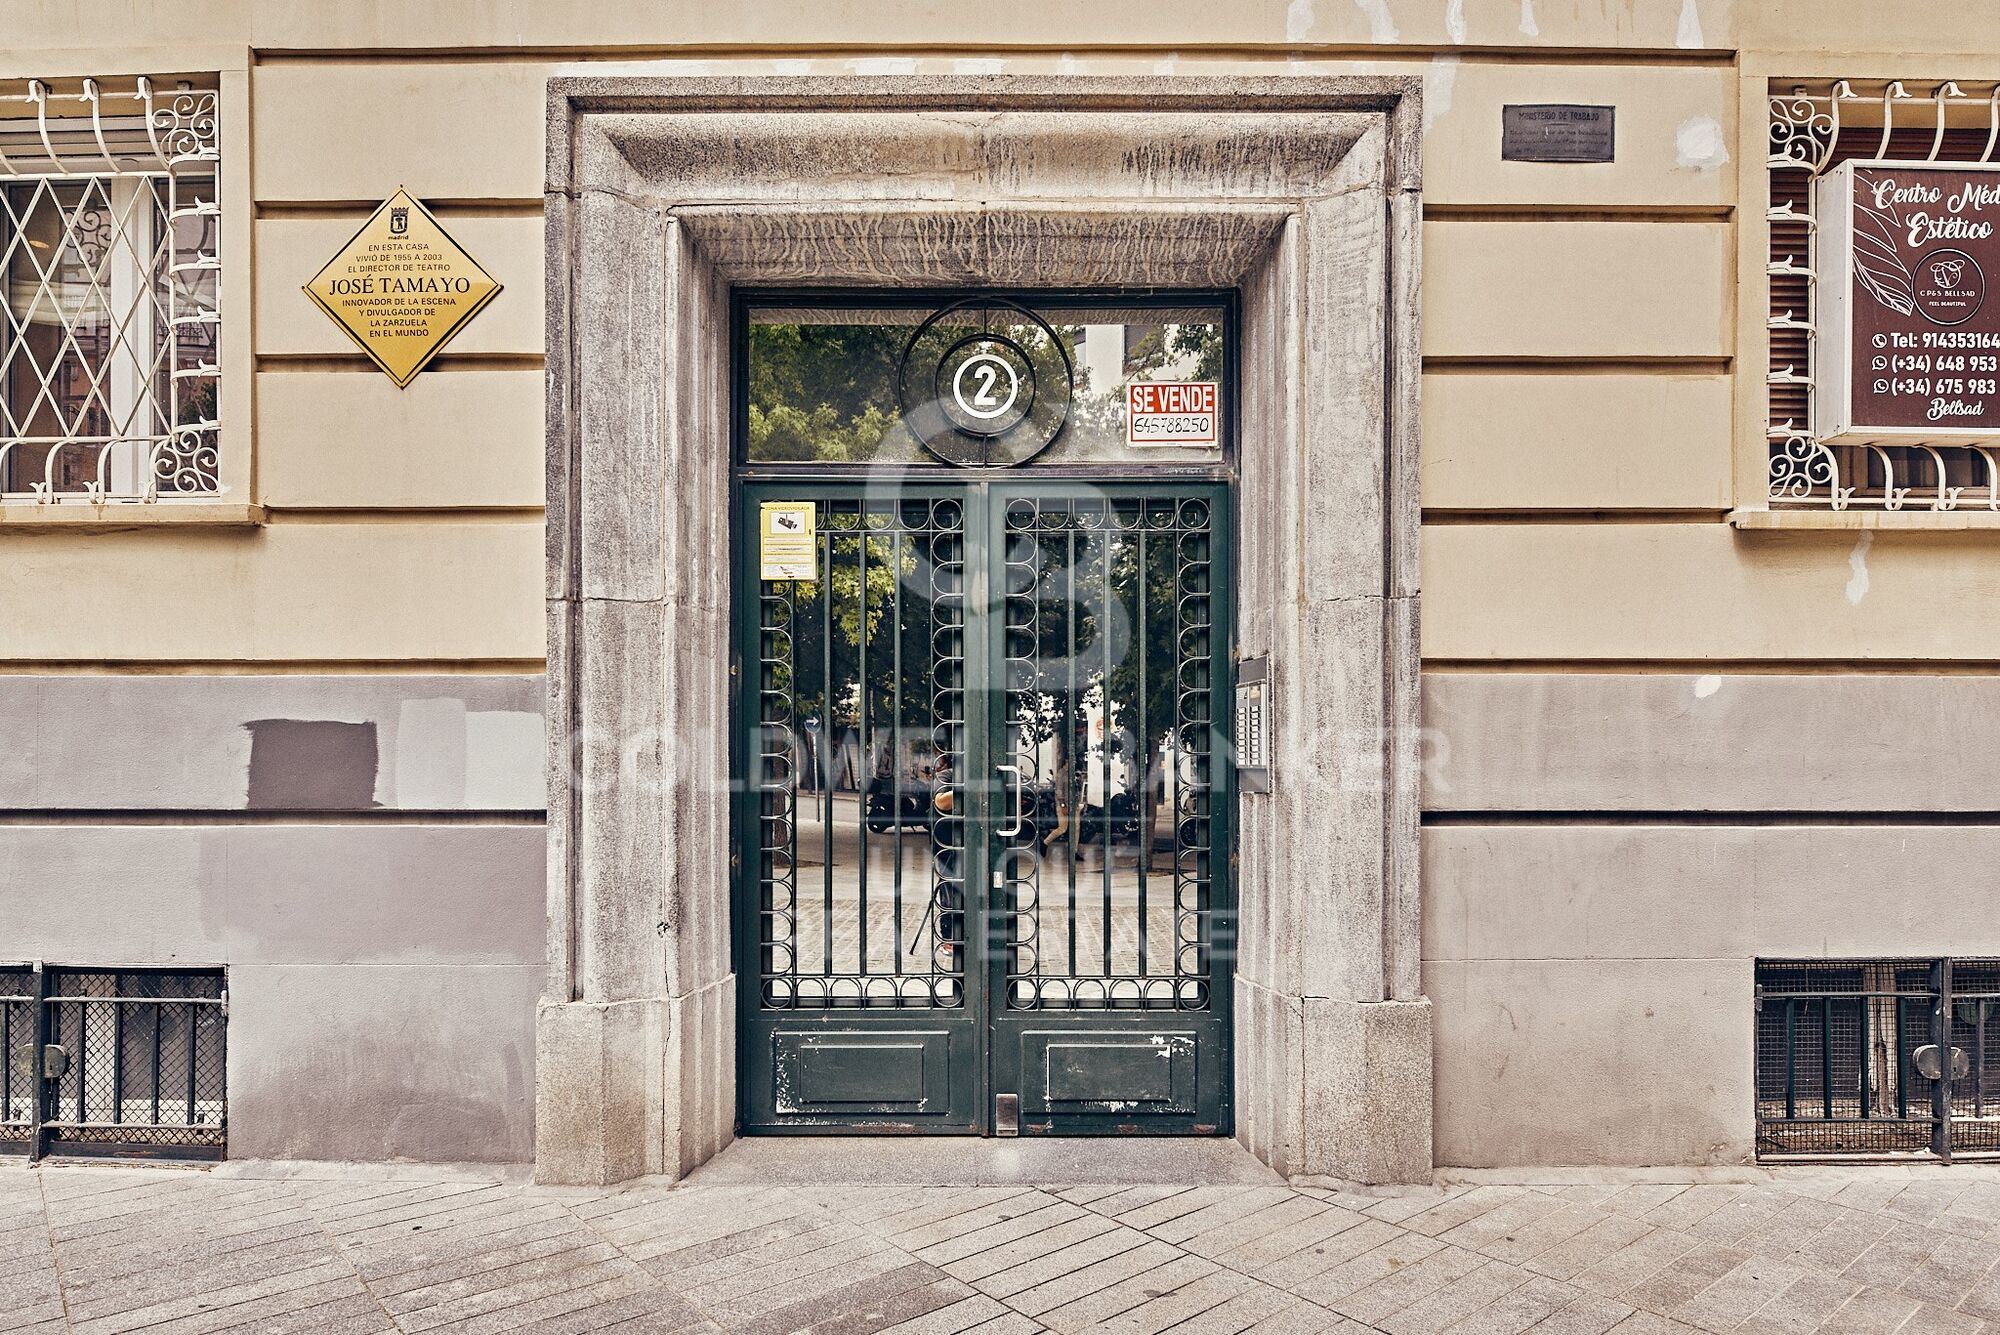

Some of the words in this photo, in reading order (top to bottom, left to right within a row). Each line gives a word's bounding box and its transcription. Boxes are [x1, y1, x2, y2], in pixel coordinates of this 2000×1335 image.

[1519, 112, 1556, 120] MINISTERIO
[1559, 112, 1567, 120] DE
[1570, 112, 1600, 120] TRABAJO
[1871, 179, 1942, 209] Centro
[1906, 212, 1993, 248] Estético
[368, 244, 380, 252] EN
[360, 264, 400, 272] DIRECTOR
[402, 264, 414, 272] DE
[417, 264, 450, 272] TEATRO
[329, 274, 374, 296] JOSÉ
[378, 277, 470, 294] TAMAYO
[342, 298, 392, 306] INNOVADOR
[394, 298, 404, 306] DE
[421, 298, 456, 306] ESCENA
[366, 308, 422, 316] DIVULGADOR
[424, 308, 436, 316] DE
[395, 329, 429, 337] MUNDO
[1890, 332, 1918, 348] Tel:
[1922, 332, 2000, 348] 914353164
[1892, 354, 1931, 373] (+34)
[1936, 356, 1965, 371] 648
[1970, 356, 1997, 371] 953
[974, 364, 997, 405] 2
[1892, 377, 1931, 396] (+34)
[1935, 379, 1963, 394] 675
[1968, 379, 1996, 394] 983
[1132, 386, 1154, 412] SE
[1158, 386, 1212, 412] VENDE
[1927, 397, 1984, 420] Bellsad
